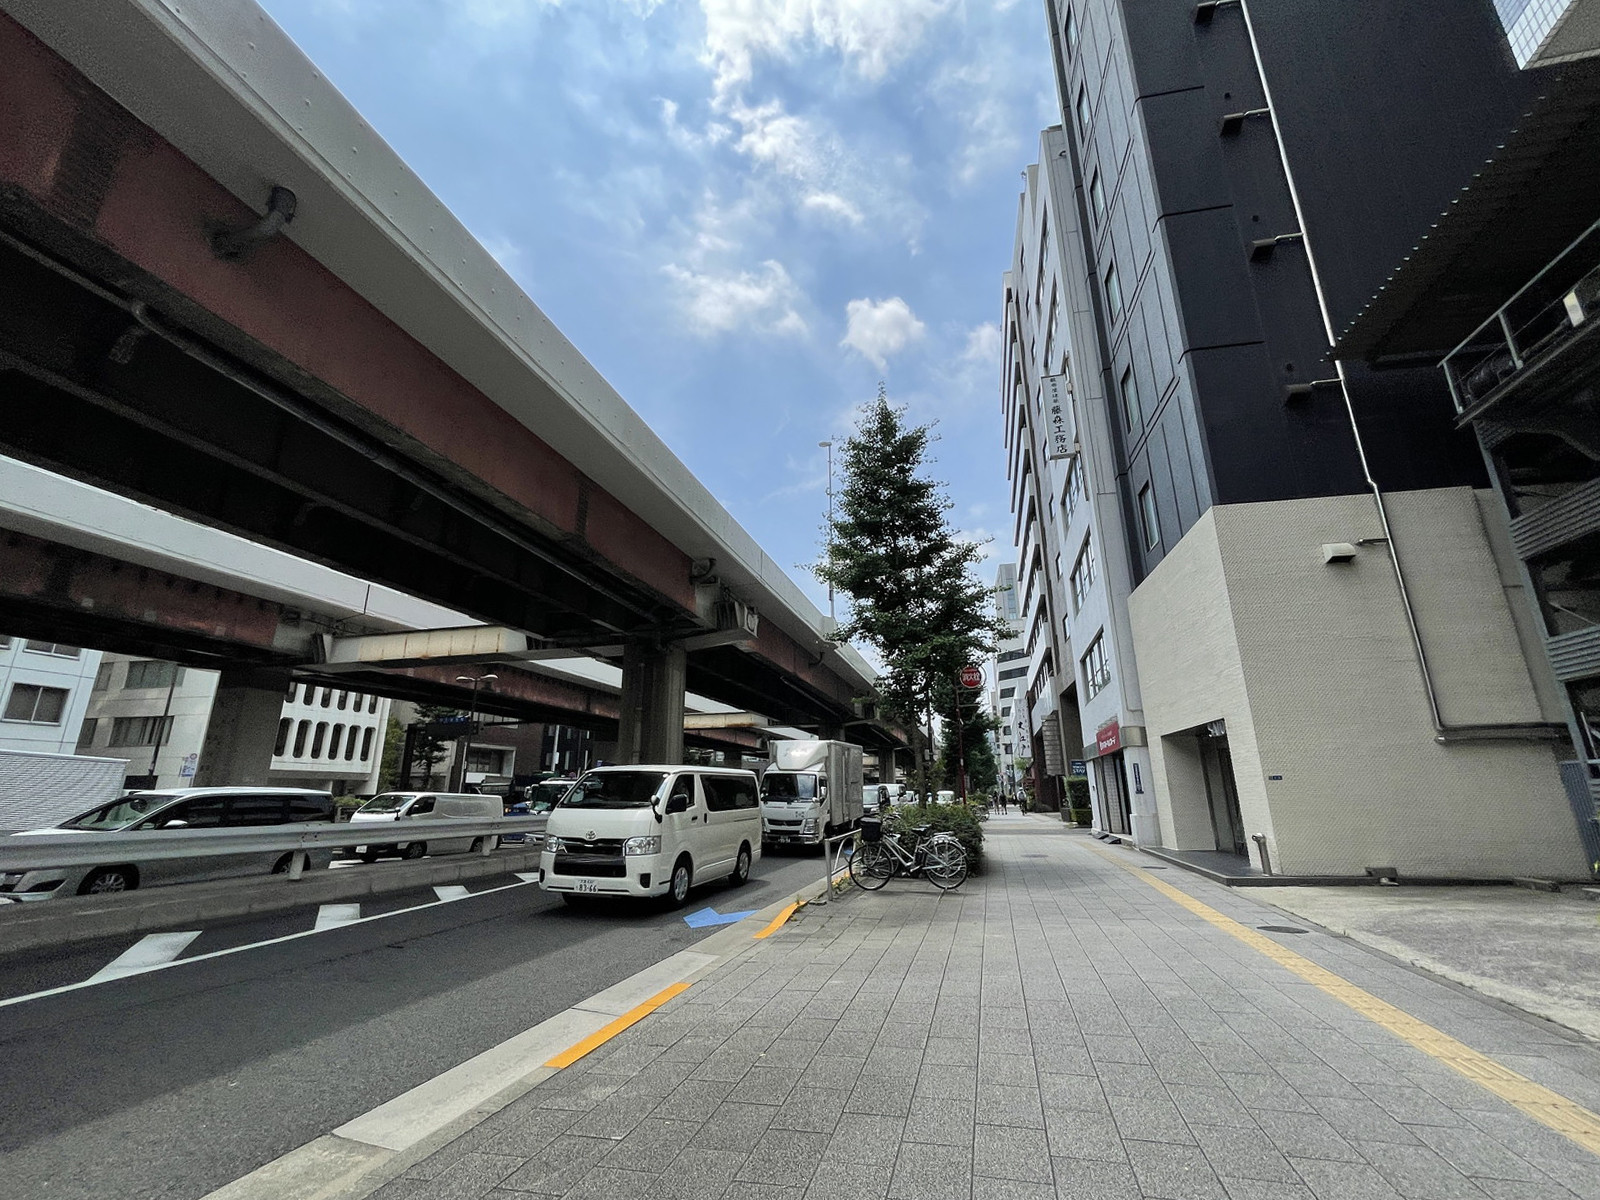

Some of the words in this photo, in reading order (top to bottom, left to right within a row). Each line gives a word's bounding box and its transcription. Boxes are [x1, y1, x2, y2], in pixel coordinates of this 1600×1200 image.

[1051, 405, 1068, 454] 藤森工務店
[961, 671, 981, 682] 消火栓
[579, 884, 597, 892] 83-66
